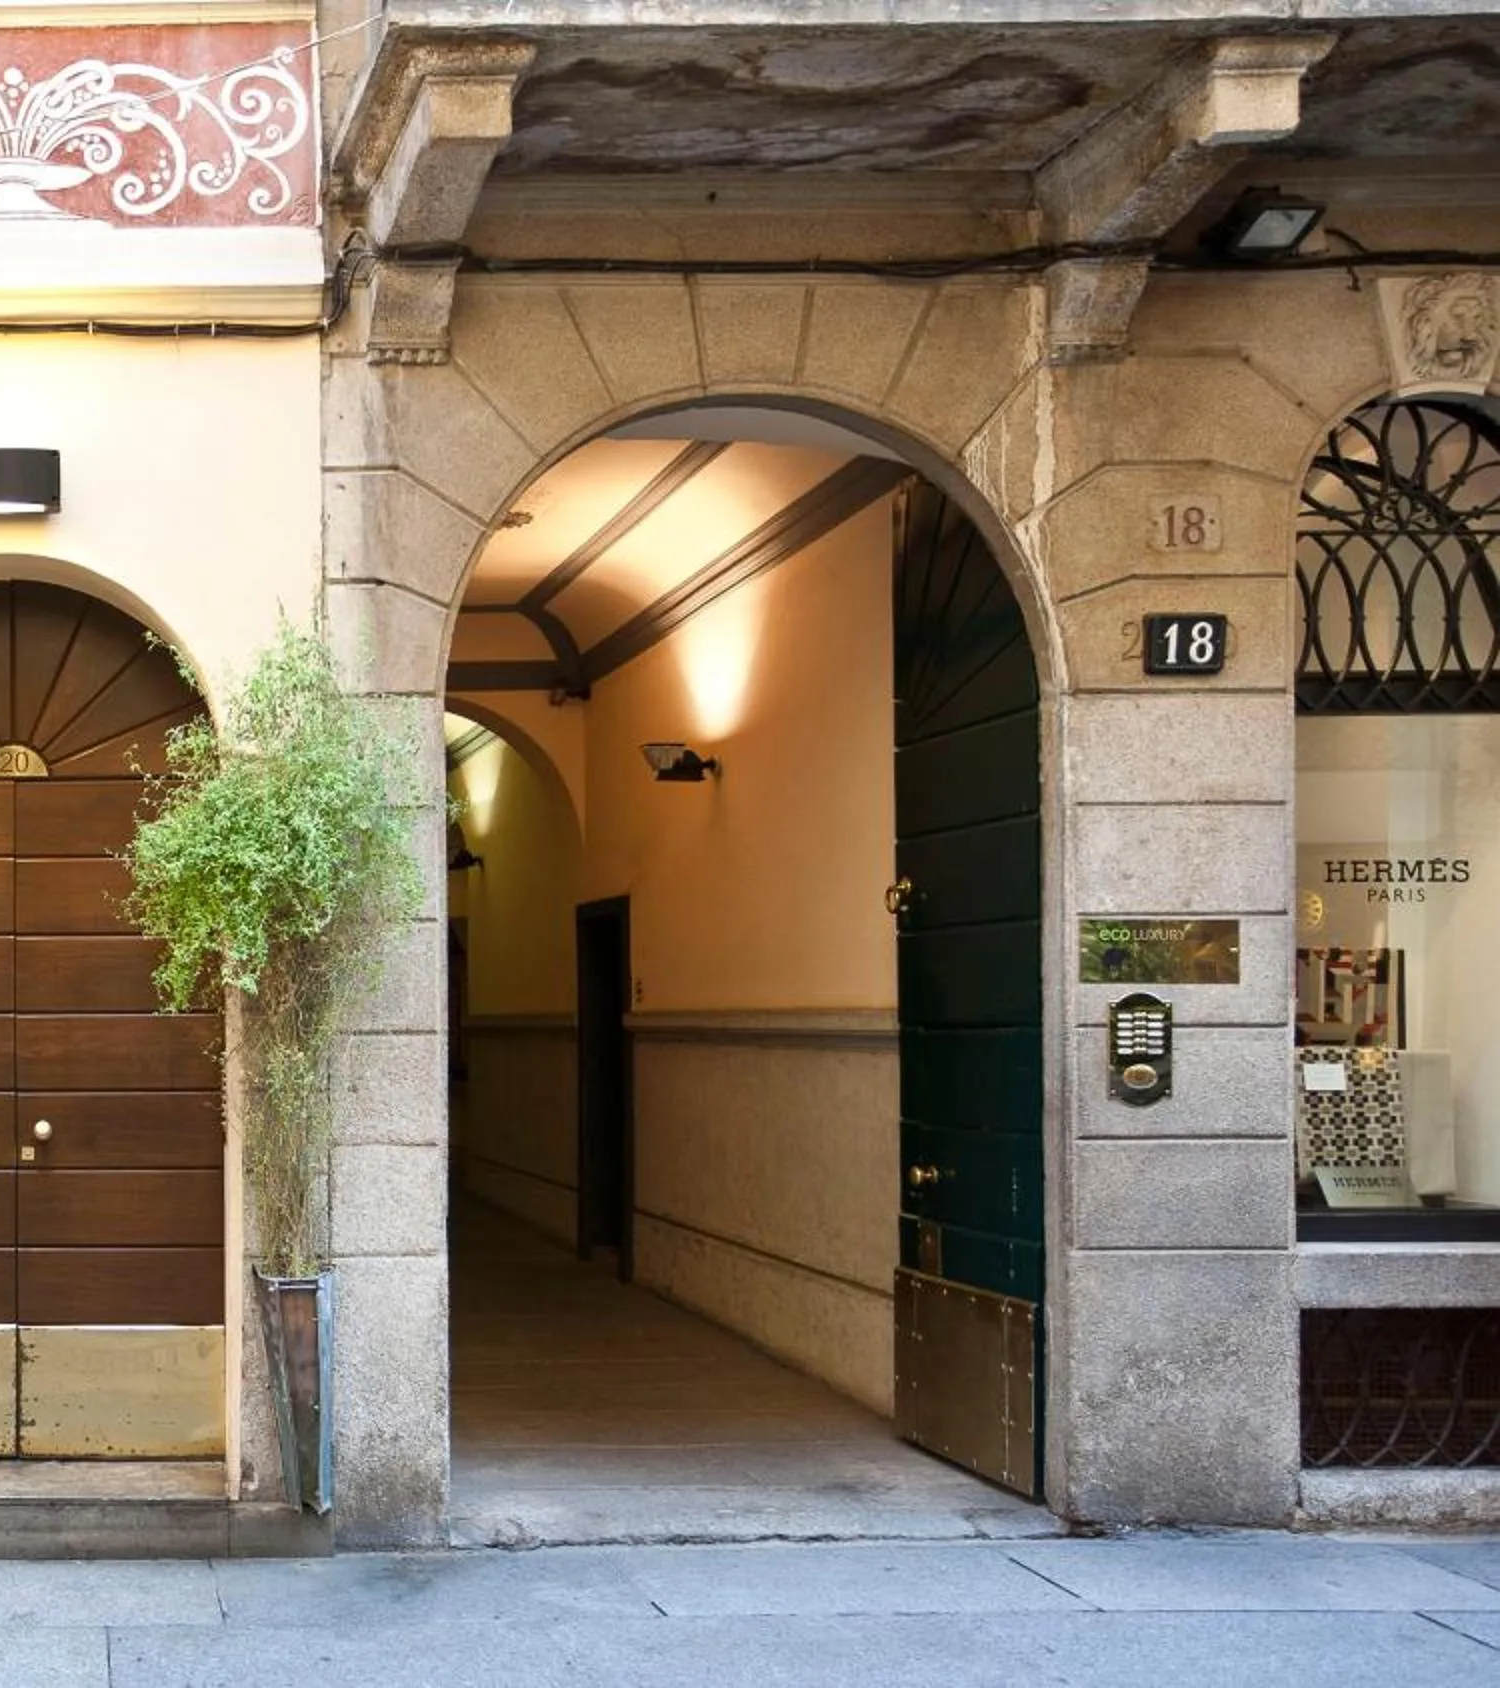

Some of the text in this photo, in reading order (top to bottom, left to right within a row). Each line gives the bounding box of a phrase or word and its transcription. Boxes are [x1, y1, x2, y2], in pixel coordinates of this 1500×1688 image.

[1164, 506, 1205, 547] 18
[1164, 621, 1214, 664] 18
[0, 751, 29, 773] 20
[1367, 888, 1426, 903] PARIS
[1099, 928, 1186, 941] eco LUXURY
